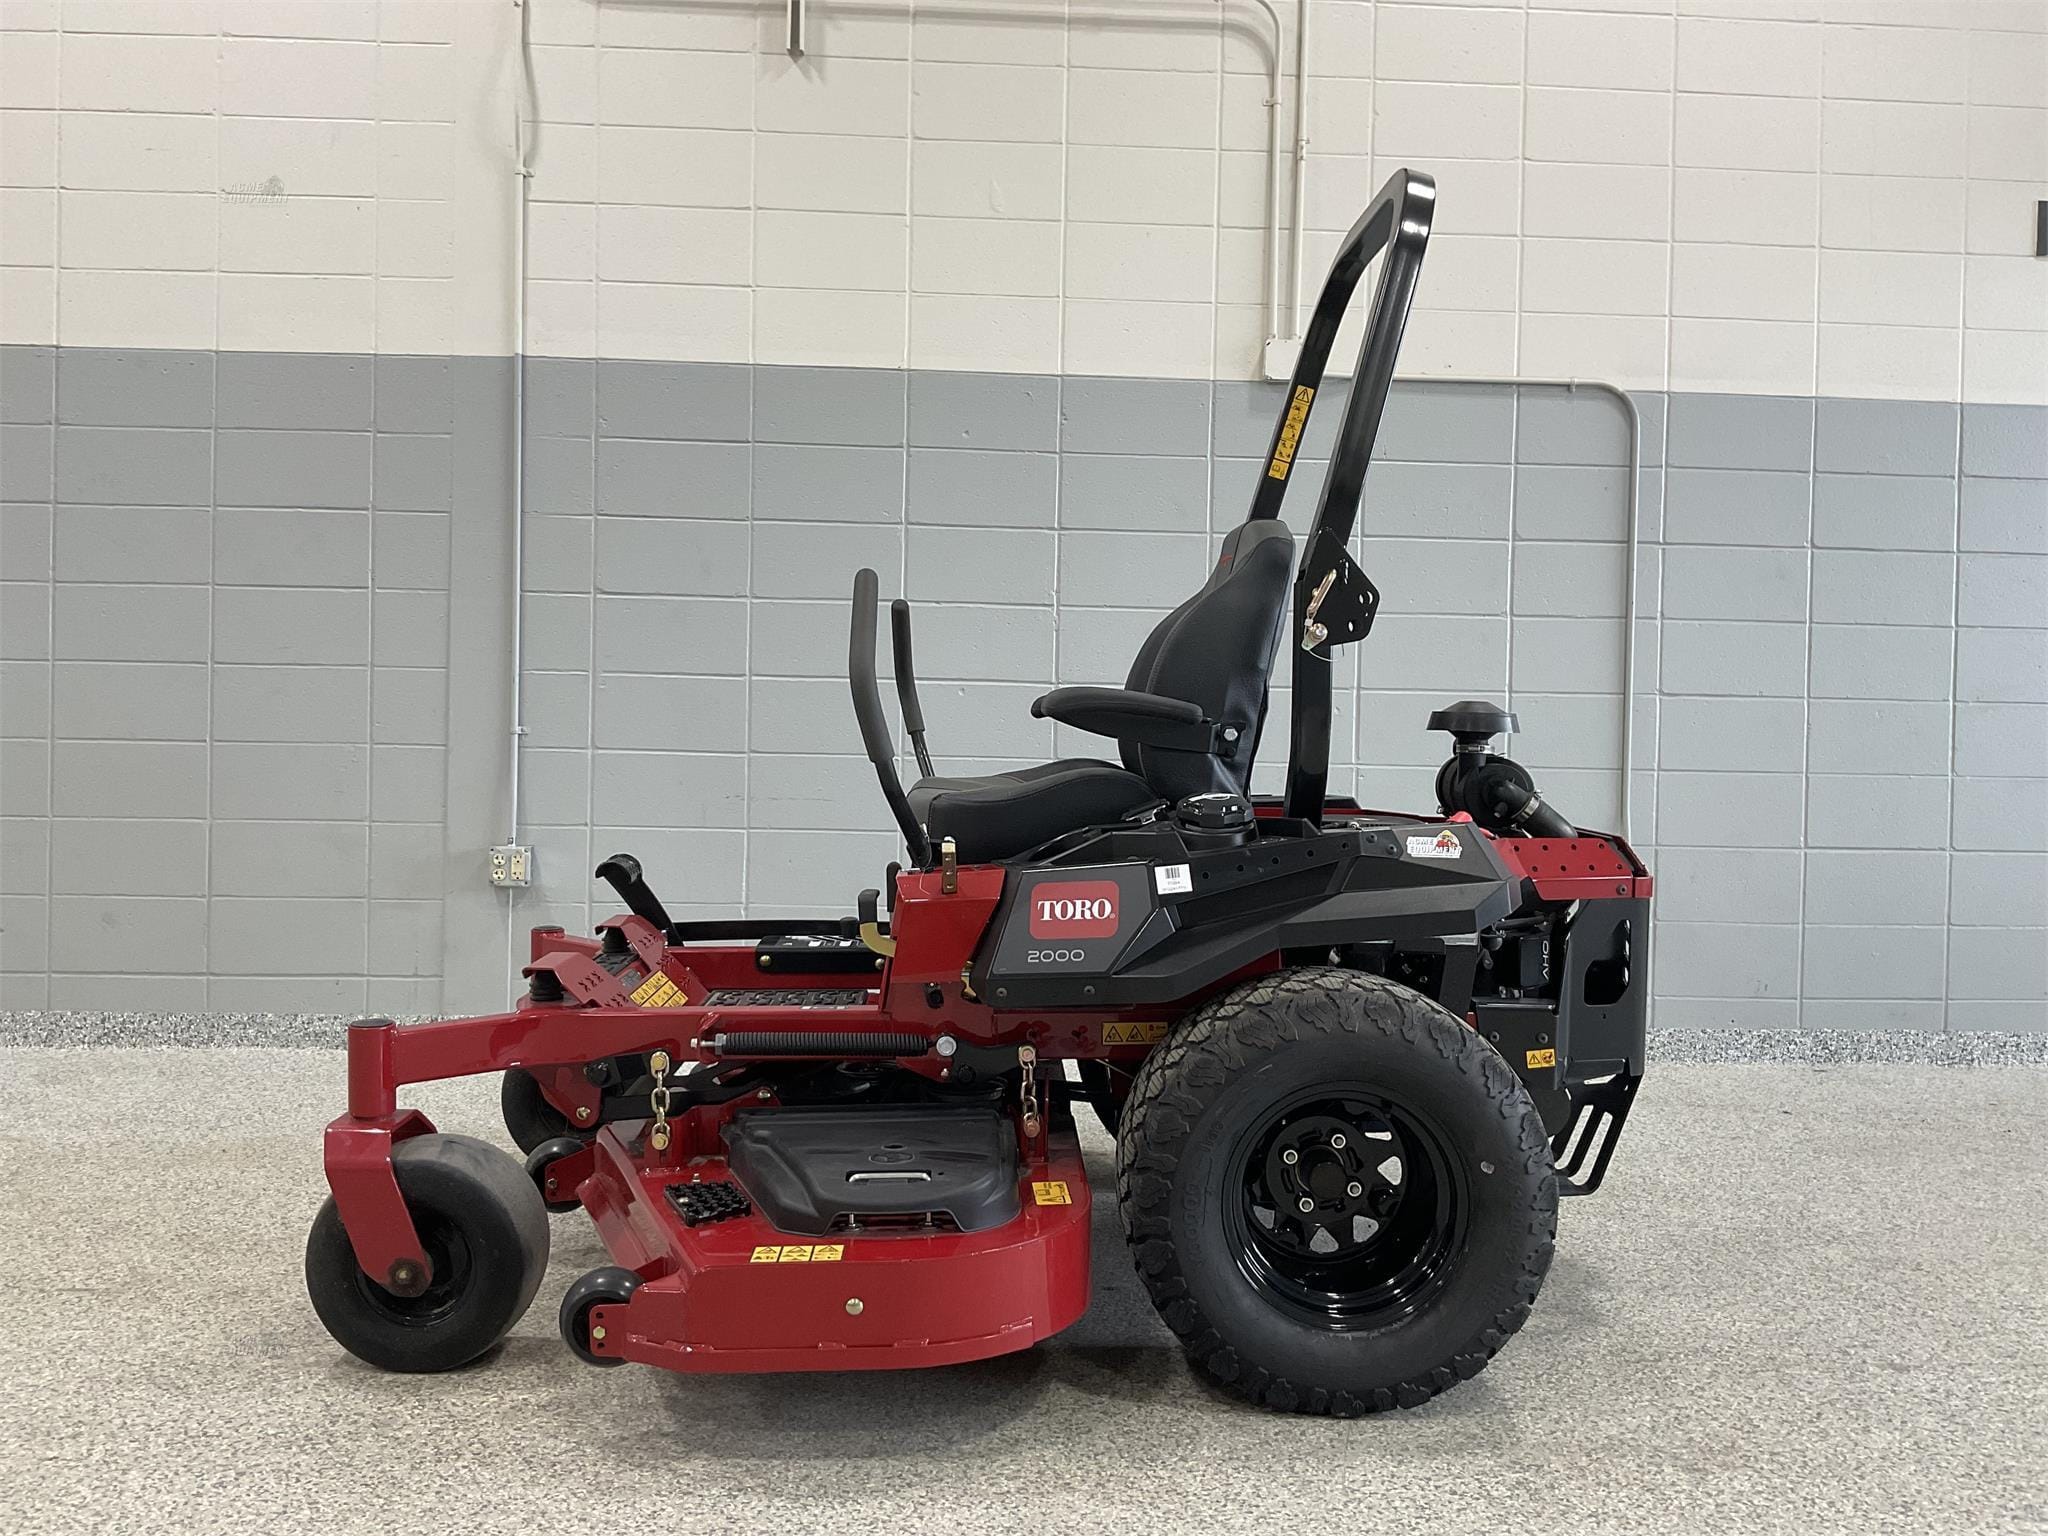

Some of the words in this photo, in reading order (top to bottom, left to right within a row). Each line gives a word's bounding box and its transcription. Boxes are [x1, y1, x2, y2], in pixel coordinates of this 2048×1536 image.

[1408, 838, 1434, 846] ACME
[1410, 845, 1461, 854] EQUIPMENT
[1038, 898, 1112, 921] TORO
[1027, 949, 1085, 963] 2000
[1542, 940, 1550, 982] OHV
